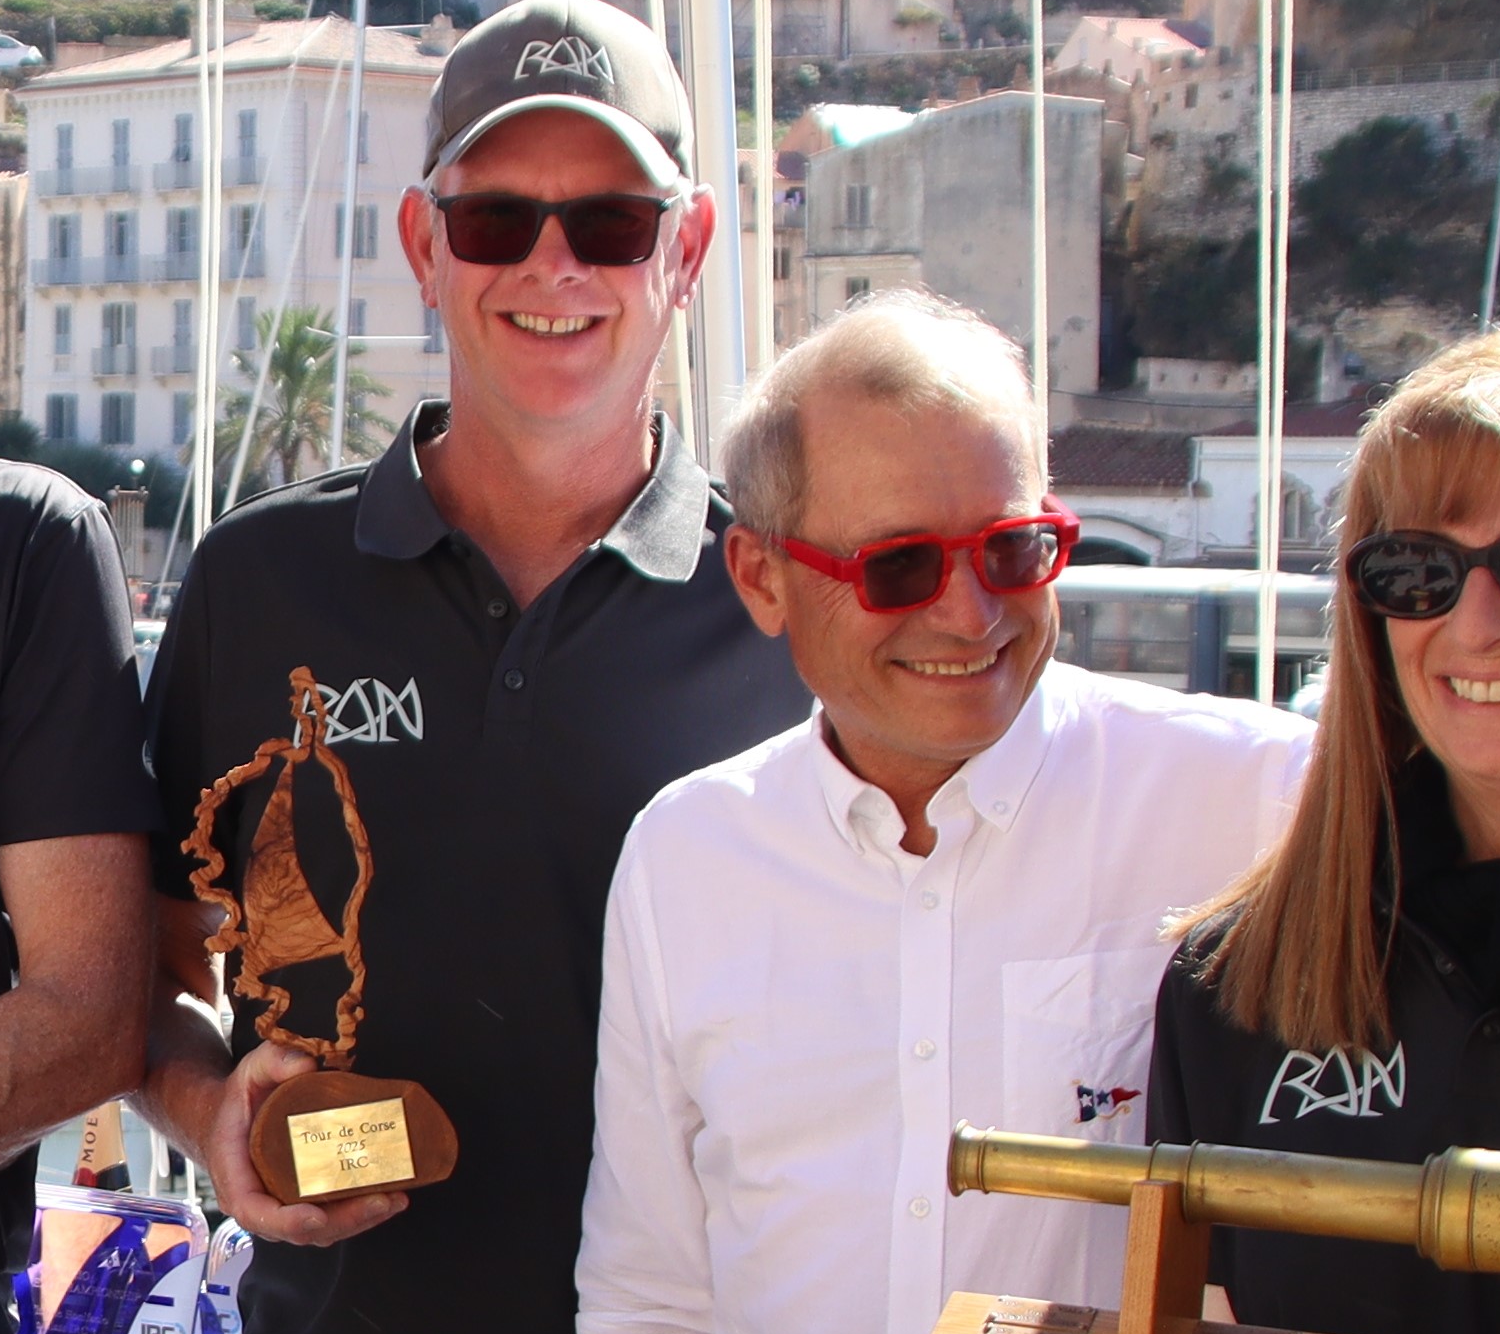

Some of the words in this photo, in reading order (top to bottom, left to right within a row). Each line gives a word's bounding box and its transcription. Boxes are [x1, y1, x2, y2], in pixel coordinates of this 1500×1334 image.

[81, 1117, 99, 1163] MOE
[300, 1130, 332, 1144] Tour
[340, 1126, 354, 1138] de
[360, 1120, 397, 1134] Corse
[337, 1139, 367, 1155] 2025
[339, 1156, 370, 1171] IRC
